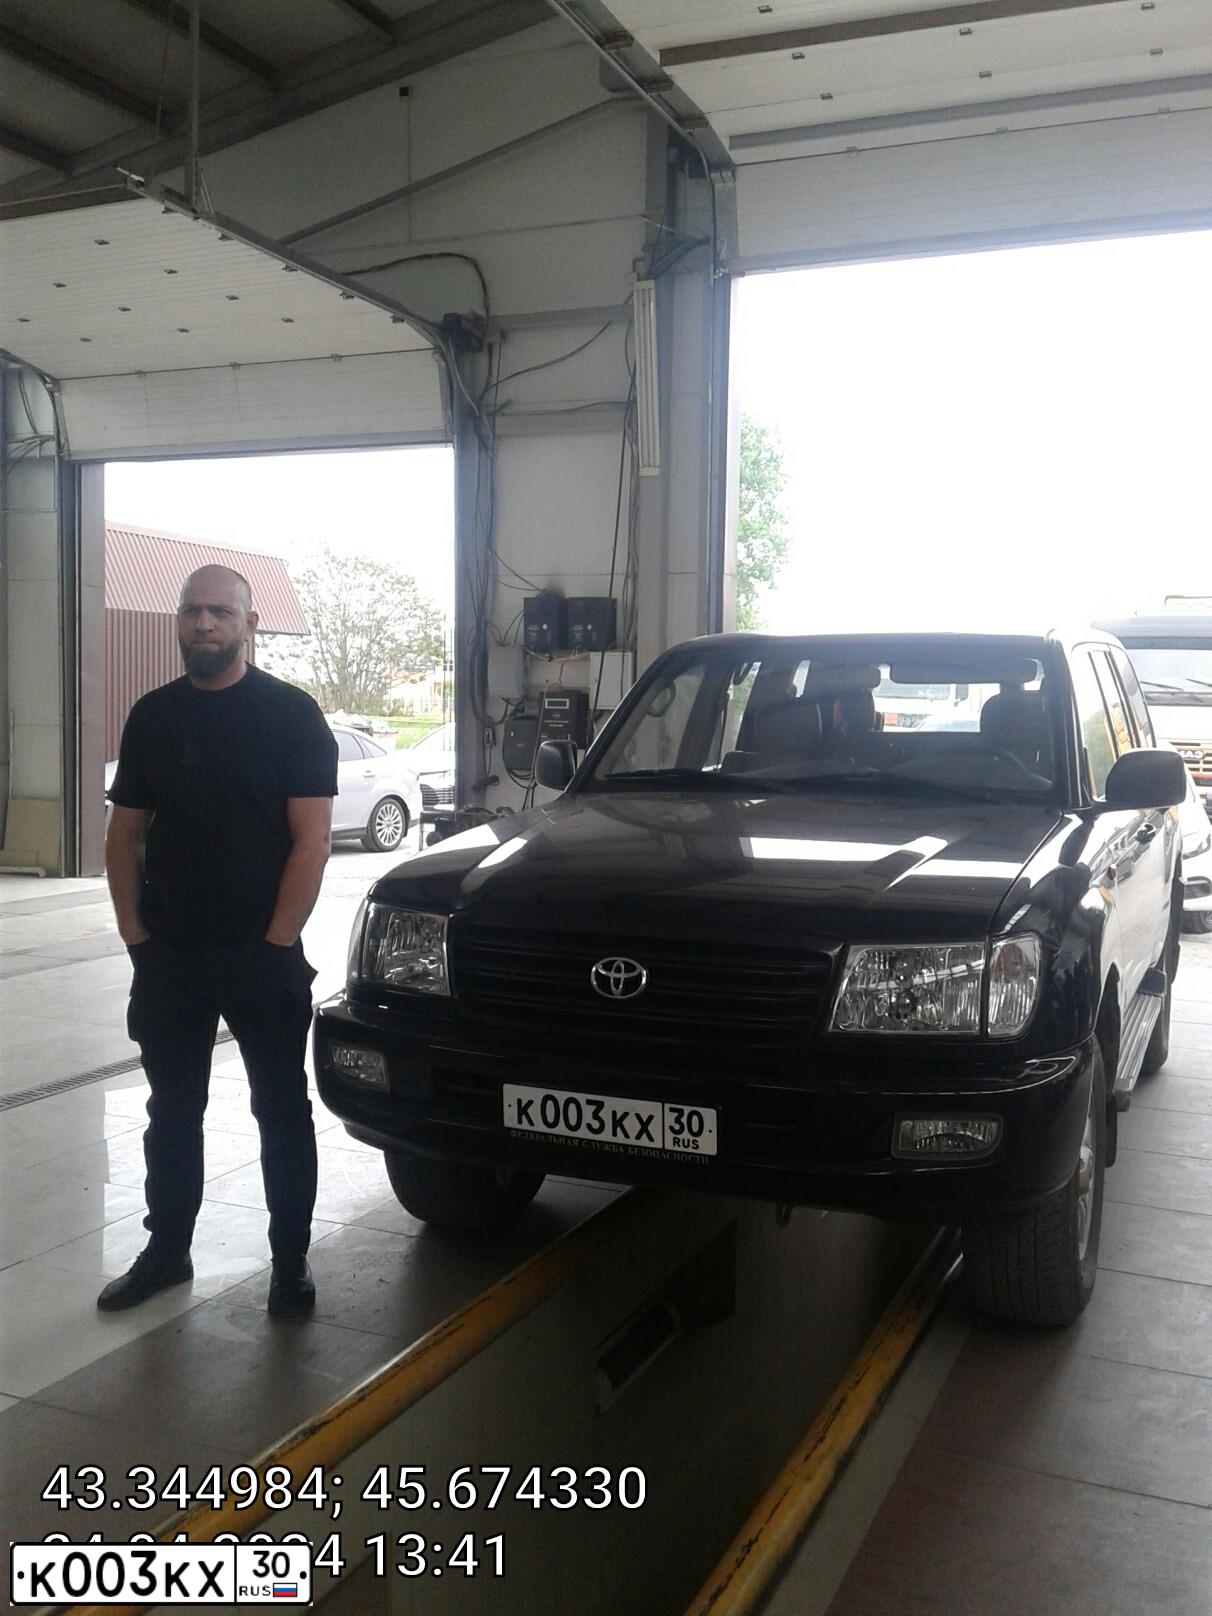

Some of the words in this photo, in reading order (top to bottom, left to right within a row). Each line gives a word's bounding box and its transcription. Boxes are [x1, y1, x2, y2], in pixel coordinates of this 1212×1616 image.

[668, 1106, 705, 1138] 30
[510, 1129, 579, 1148] ФЕДЕРАЛЬНАЯ
[582, 1139, 624, 1154] СЛУЖБА
[628, 1146, 709, 1165] БЕЗОПАСНОСТИ
[672, 1136, 700, 1150] RUS
